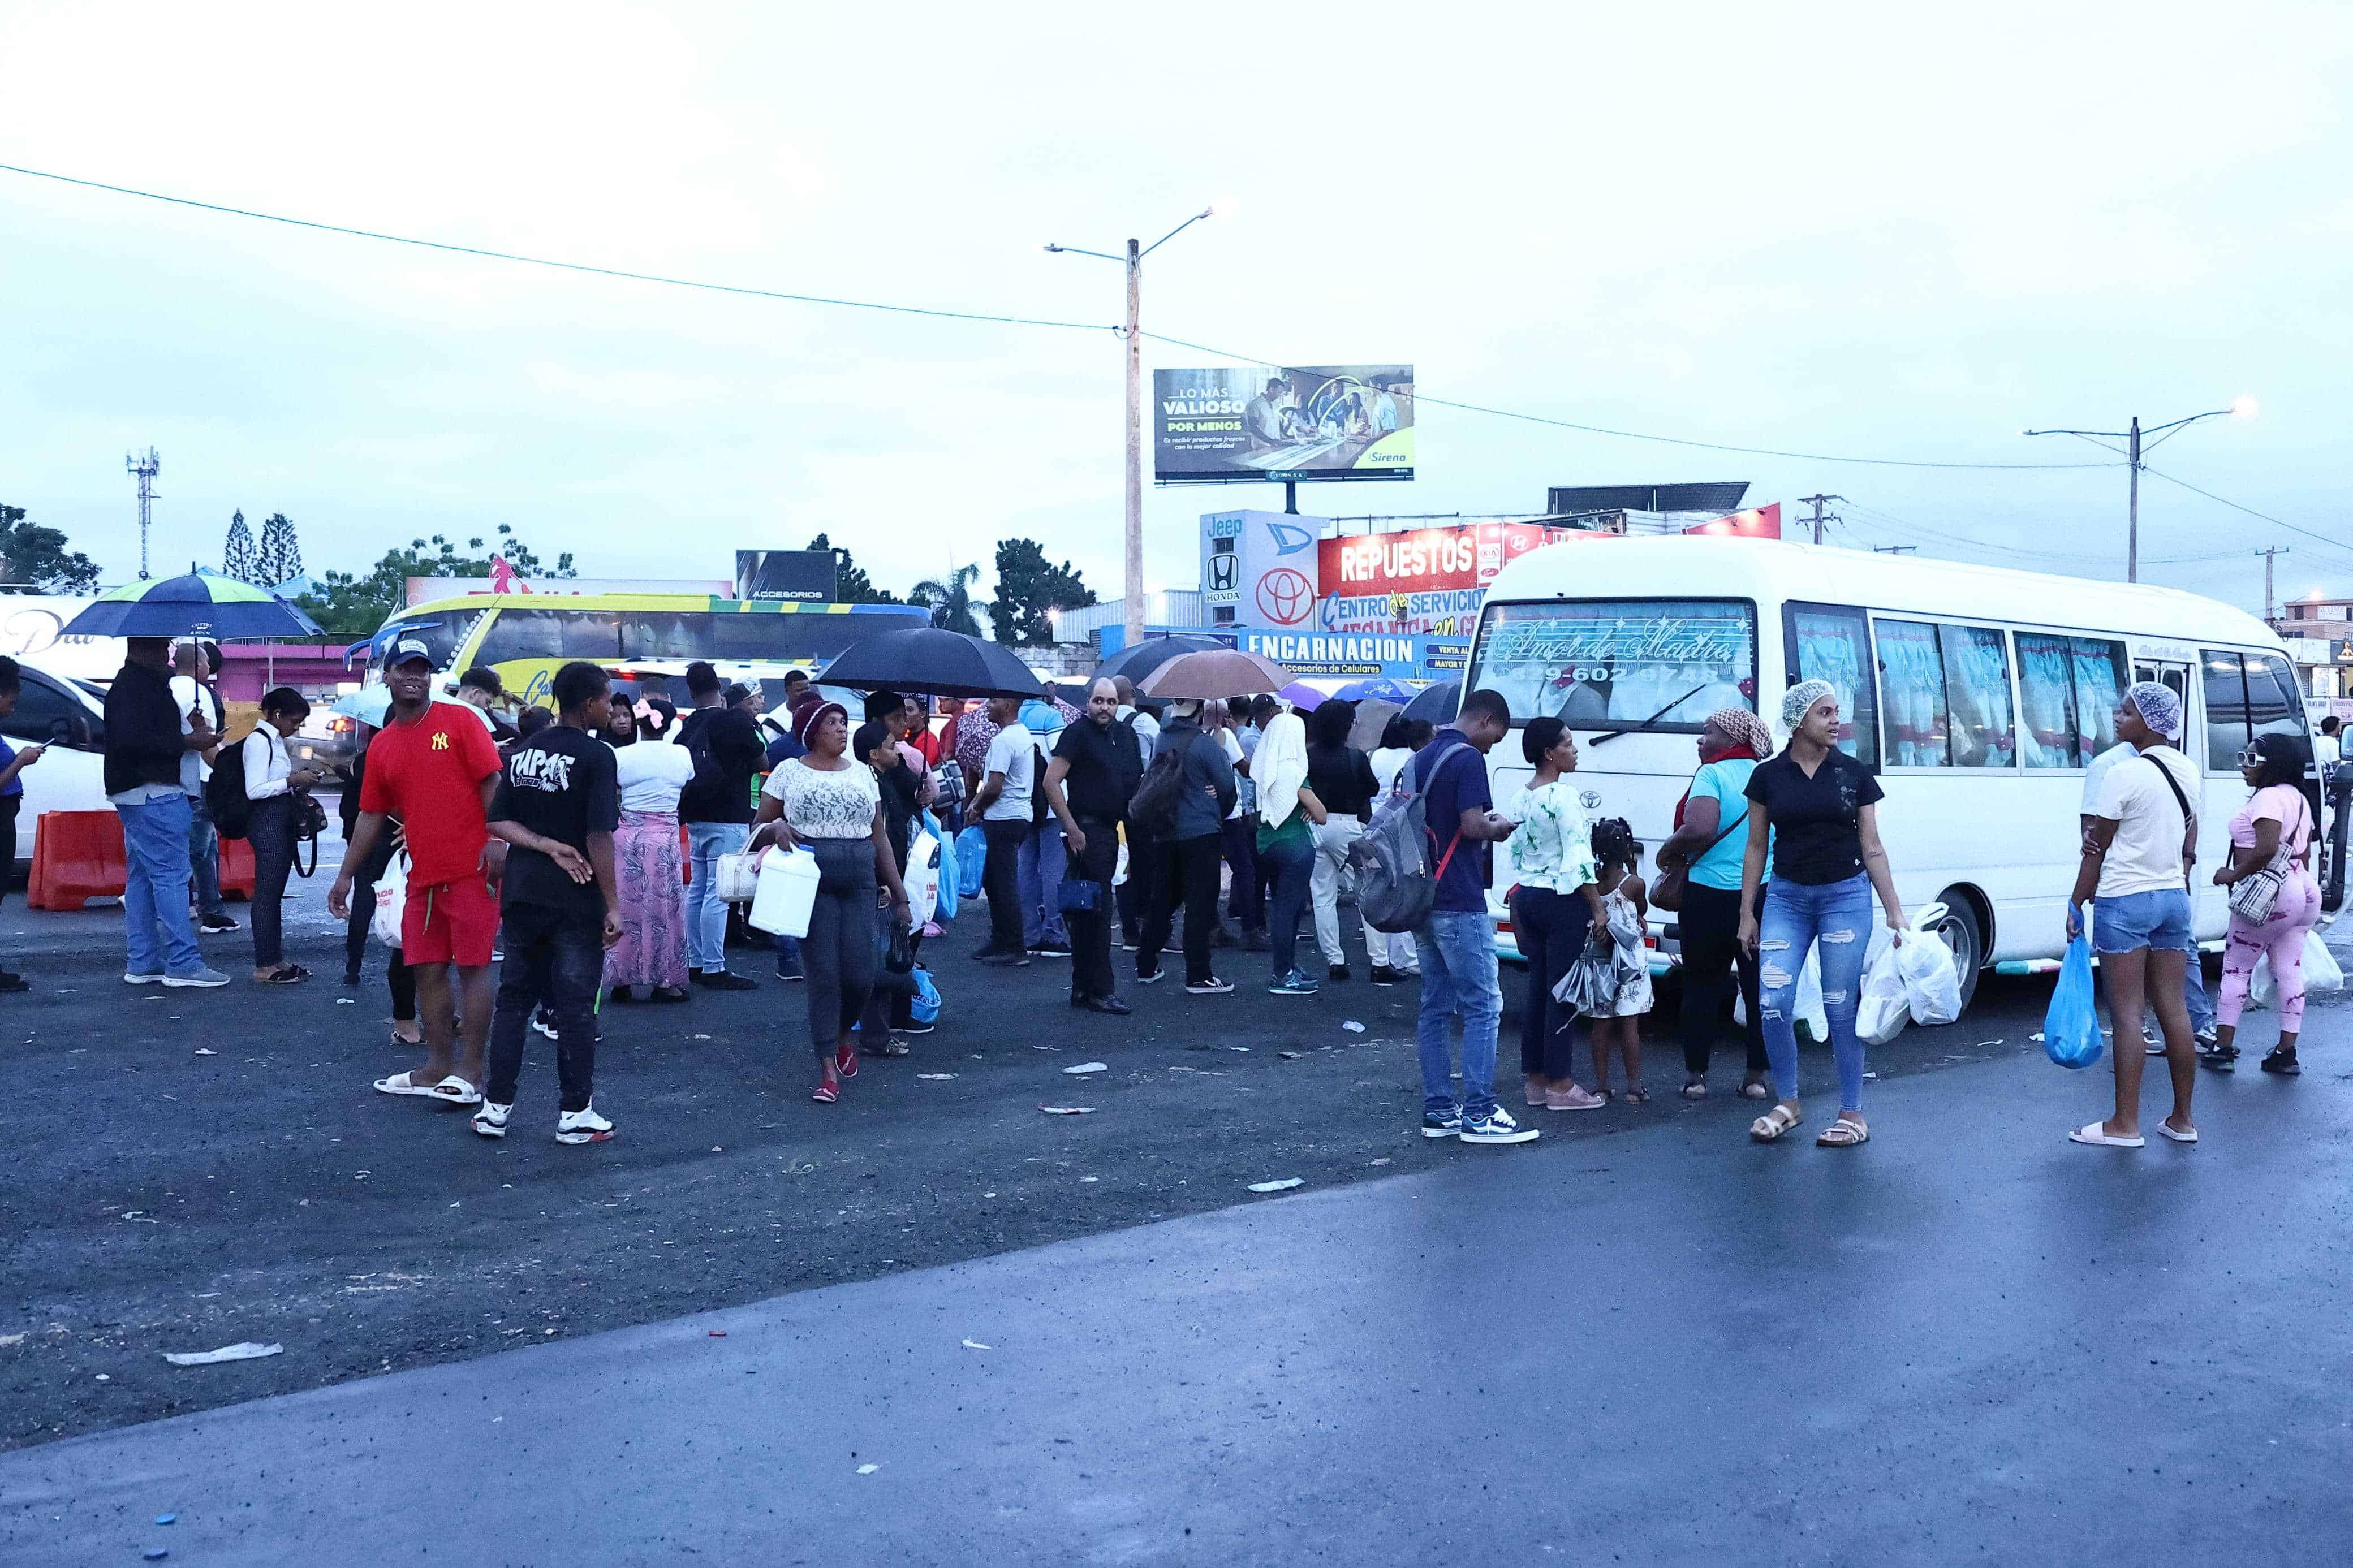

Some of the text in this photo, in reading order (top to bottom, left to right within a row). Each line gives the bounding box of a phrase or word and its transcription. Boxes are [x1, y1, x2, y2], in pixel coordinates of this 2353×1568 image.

[1180, 386, 1228, 398] LO MÁS
[1163, 400, 1245, 414] VALIOSO
[1167, 421, 1242, 432] POR MENOS
[1371, 452, 1406, 462] Sirena
[1208, 516, 1243, 538] Jeep
[1341, 536, 1473, 582] REPUESTOS
[1206, 592, 1240, 602] HONDA
[1321, 590, 1388, 626] CENTRO
[1389, 589, 1408, 617] de
[1433, 616, 1459, 636] en
[1494, 618, 1735, 660] Amor de Madre
[1248, 634, 1413, 662] ENCARNACION
[1438, 646, 1459, 654] VENTA
[1282, 663, 1380, 674] Accesorios de Celulares
[1434, 660, 1458, 668] MAYOR
